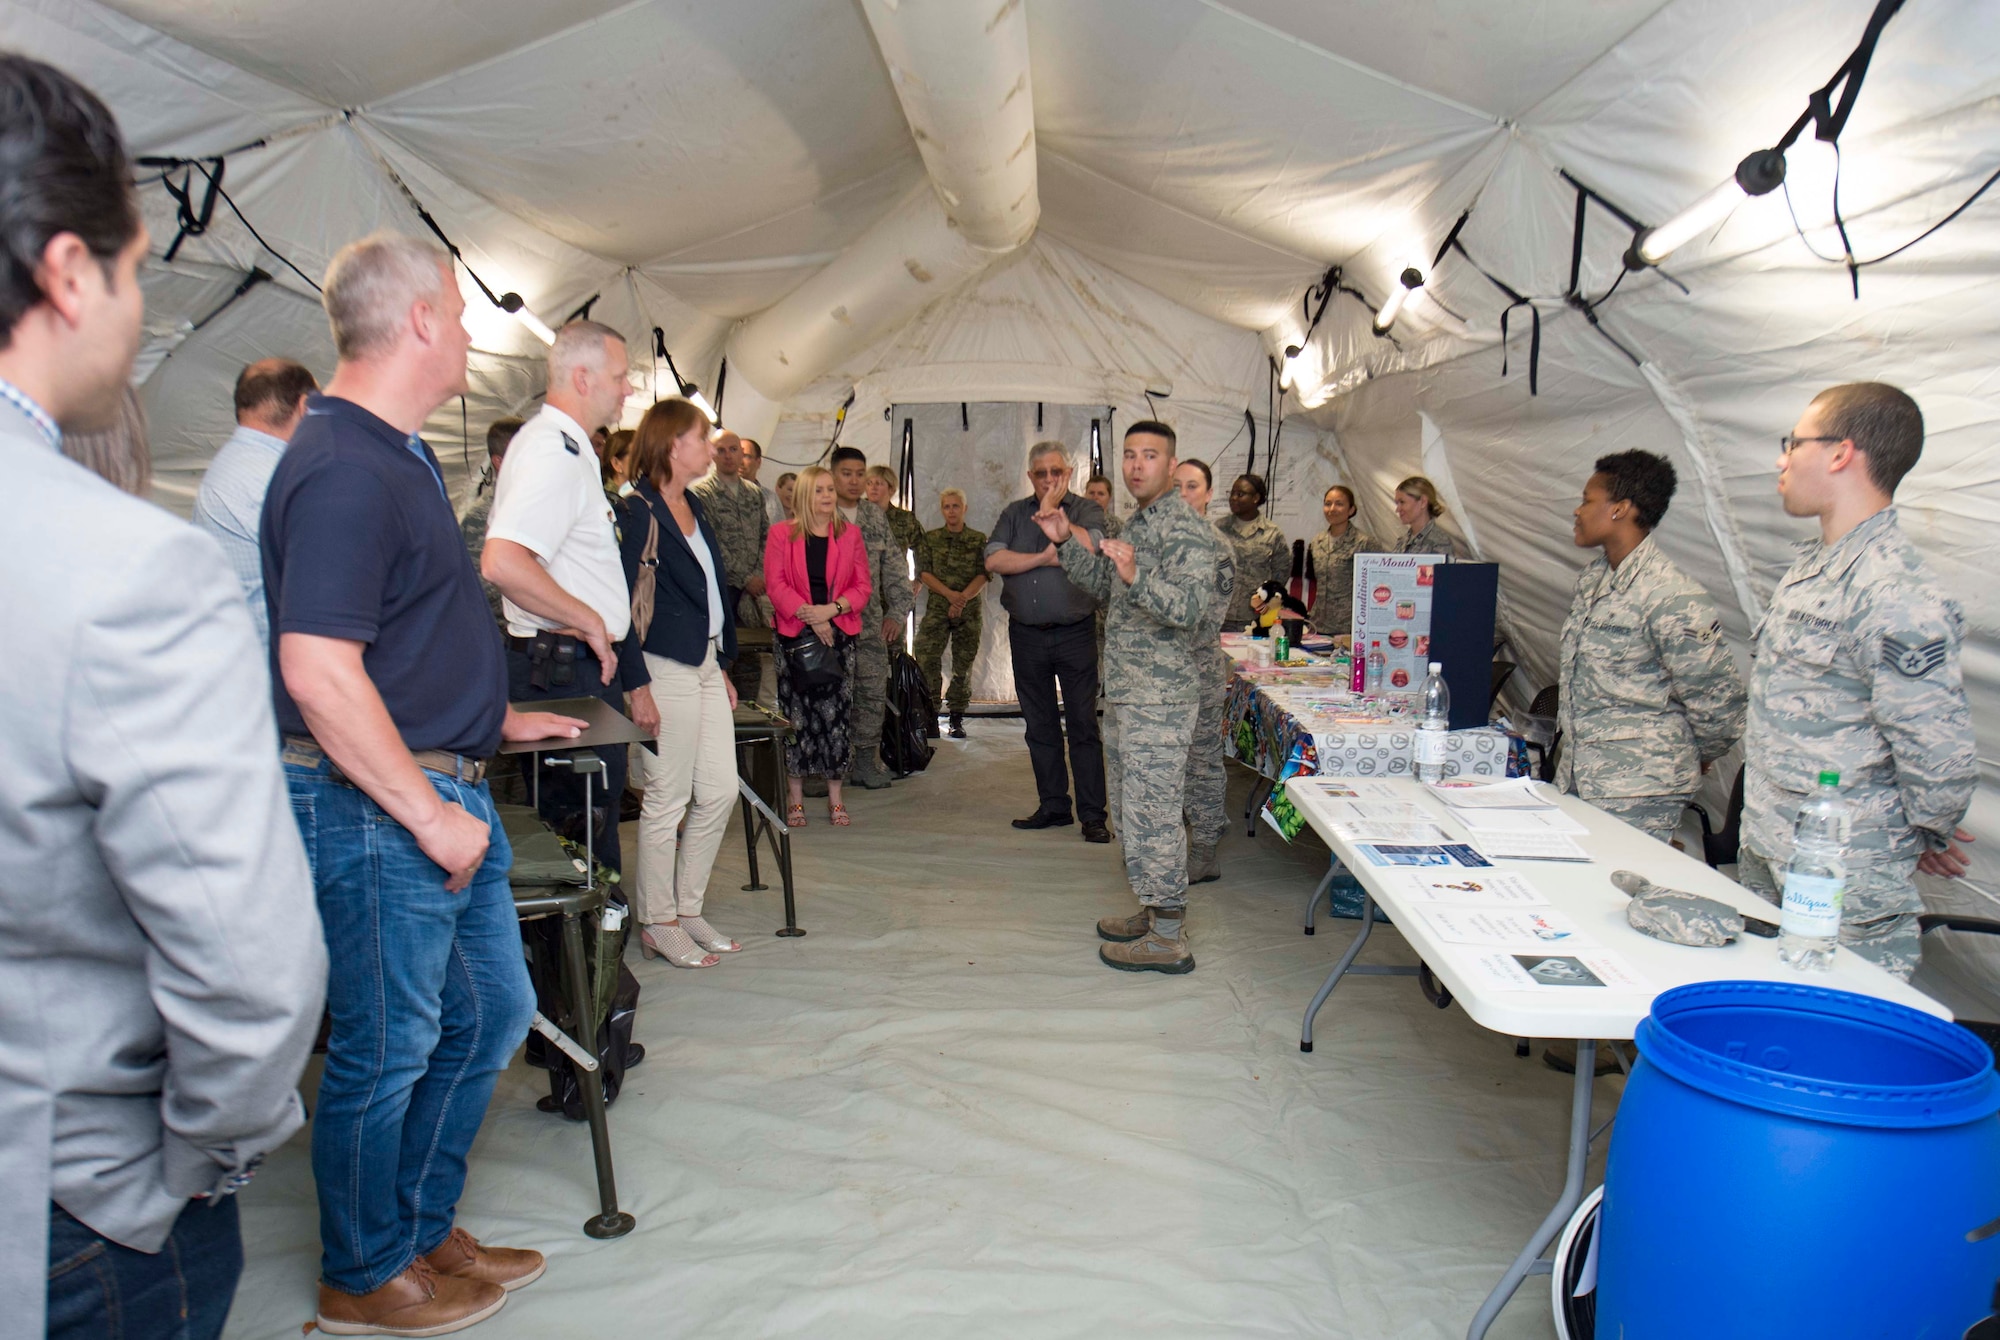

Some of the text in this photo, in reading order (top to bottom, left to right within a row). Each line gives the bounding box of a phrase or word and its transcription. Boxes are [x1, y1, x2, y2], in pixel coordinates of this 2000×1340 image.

[1379, 557, 1417, 568] Mouth
[1355, 567, 1368, 640] & Conditions
